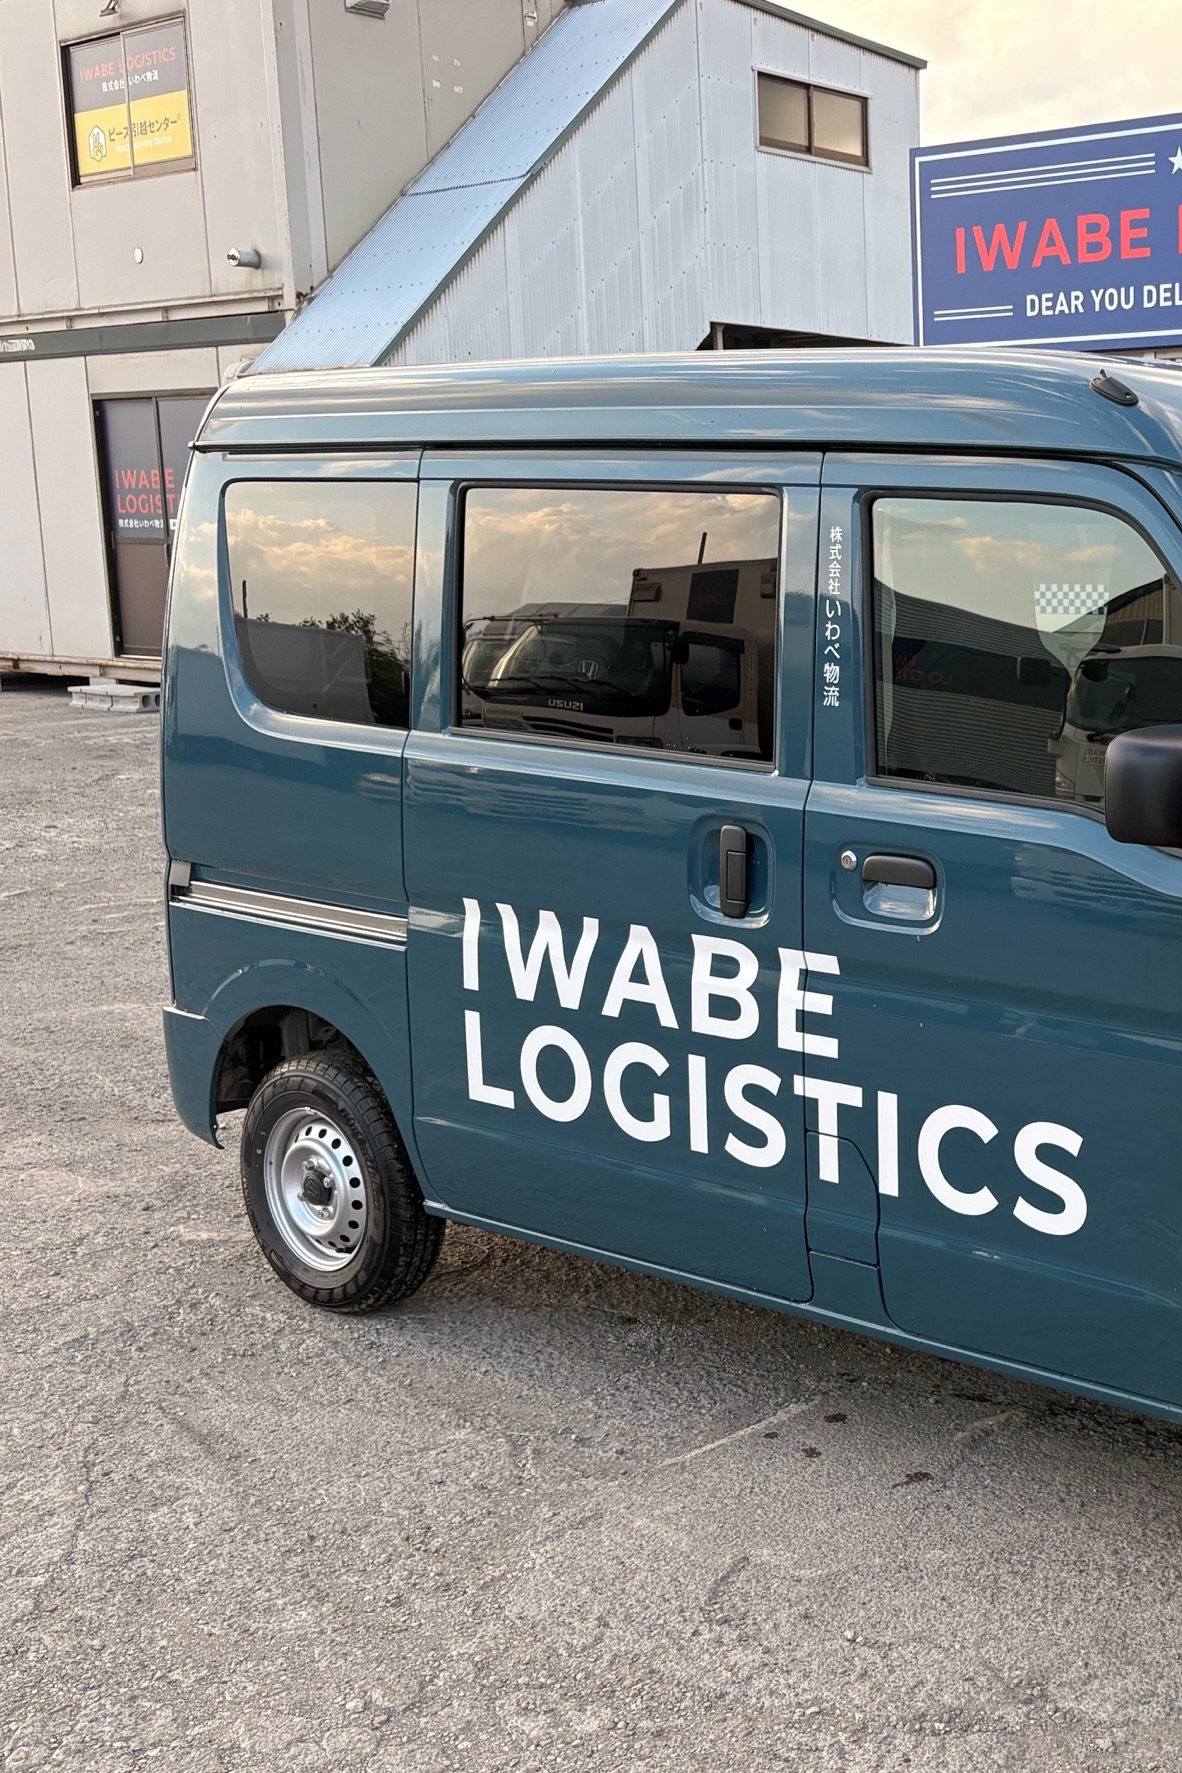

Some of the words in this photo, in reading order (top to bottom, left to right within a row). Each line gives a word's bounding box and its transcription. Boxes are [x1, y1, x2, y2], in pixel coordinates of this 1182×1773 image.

[80, 62, 114, 82] IWABE
[119, 47, 176, 74] LOGISTICS
[108, 116, 178, 142] ピース引越センター
[955, 207, 1151, 274] IWABE
[1026, 290, 1084, 317] DEAR
[1091, 286, 1135, 312] YOU
[114, 468, 175, 489] IWABE
[823, 525, 843, 707] 株式会社いわべ物流
[462, 896, 840, 1060] IWABE
[463, 1008, 1089, 1237] LOGISTICS
